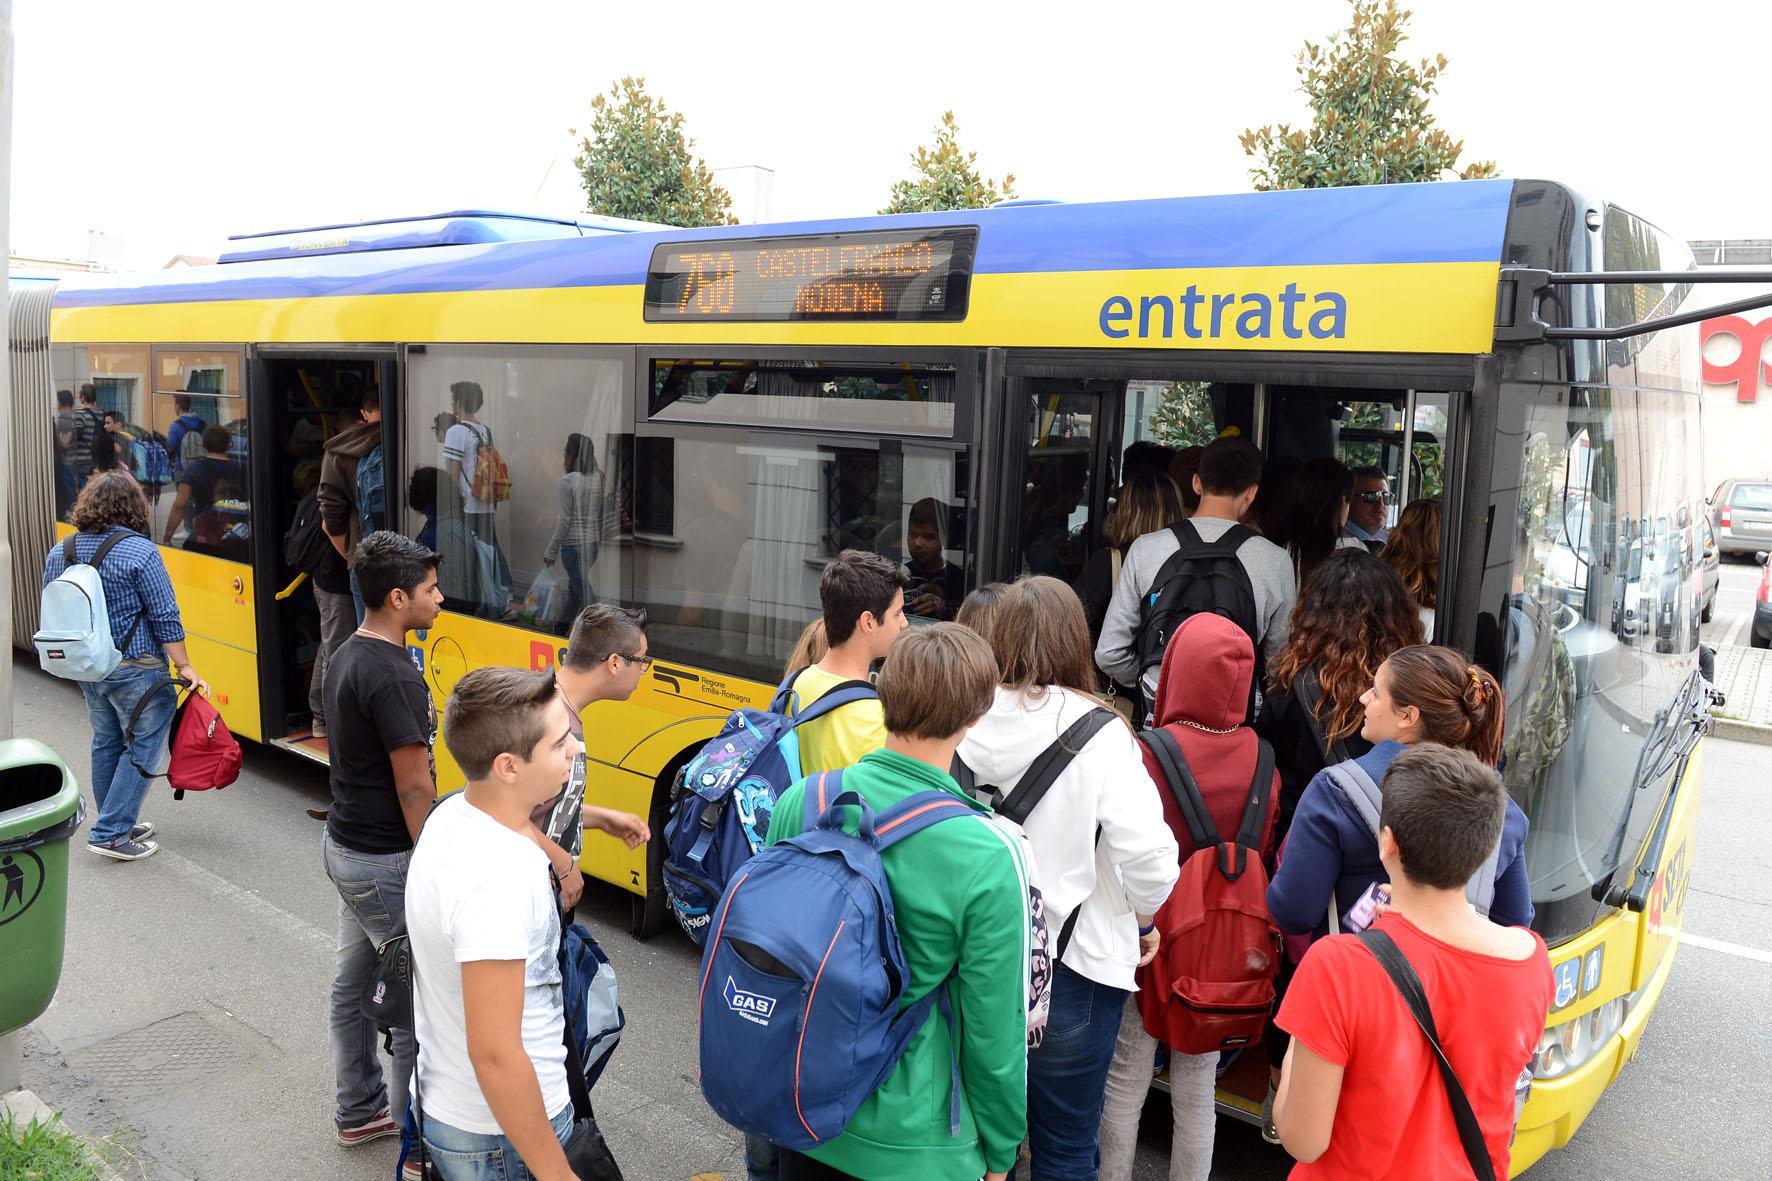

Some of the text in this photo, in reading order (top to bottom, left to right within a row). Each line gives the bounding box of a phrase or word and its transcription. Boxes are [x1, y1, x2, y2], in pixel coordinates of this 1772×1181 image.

[679, 252, 735, 313] 760
[796, 281, 883, 313] MODENA
[1098, 283, 1346, 340] entrata
[701, 677, 726, 689] Regione
[701, 685, 752, 704] Emilia-Romagna
[732, 994, 769, 1013] GAS
